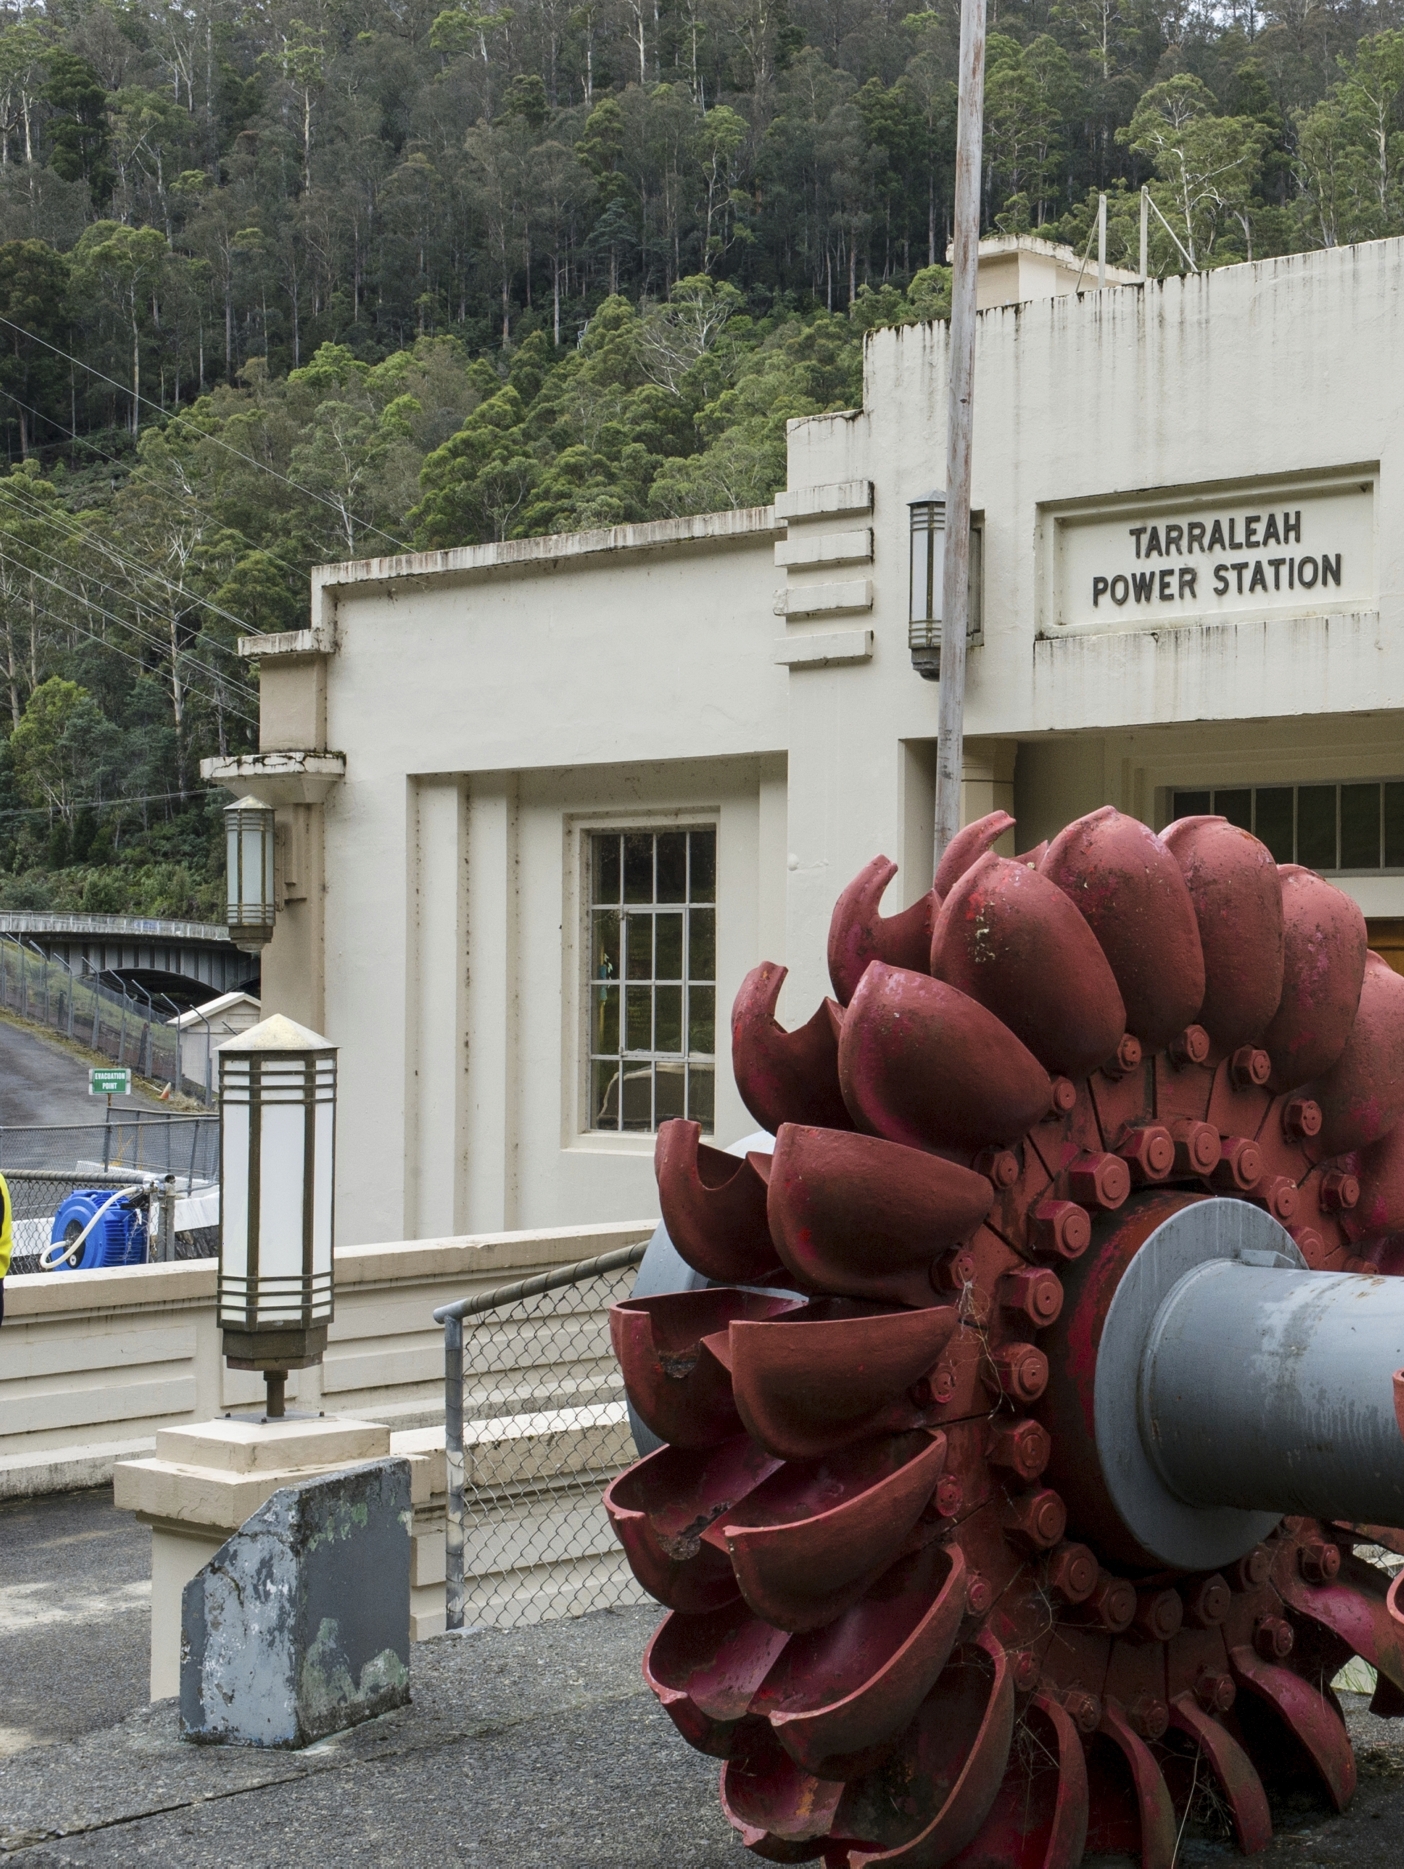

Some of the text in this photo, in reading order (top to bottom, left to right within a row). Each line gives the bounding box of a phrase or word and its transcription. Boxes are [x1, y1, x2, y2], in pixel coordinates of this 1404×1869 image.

[1129, 510, 1301, 559] TARRALEAH
[1092, 553, 1342, 607] POWER STATION
[94, 1072, 126, 1080] EVACUATION
[102, 1082, 118, 1090] POINT
